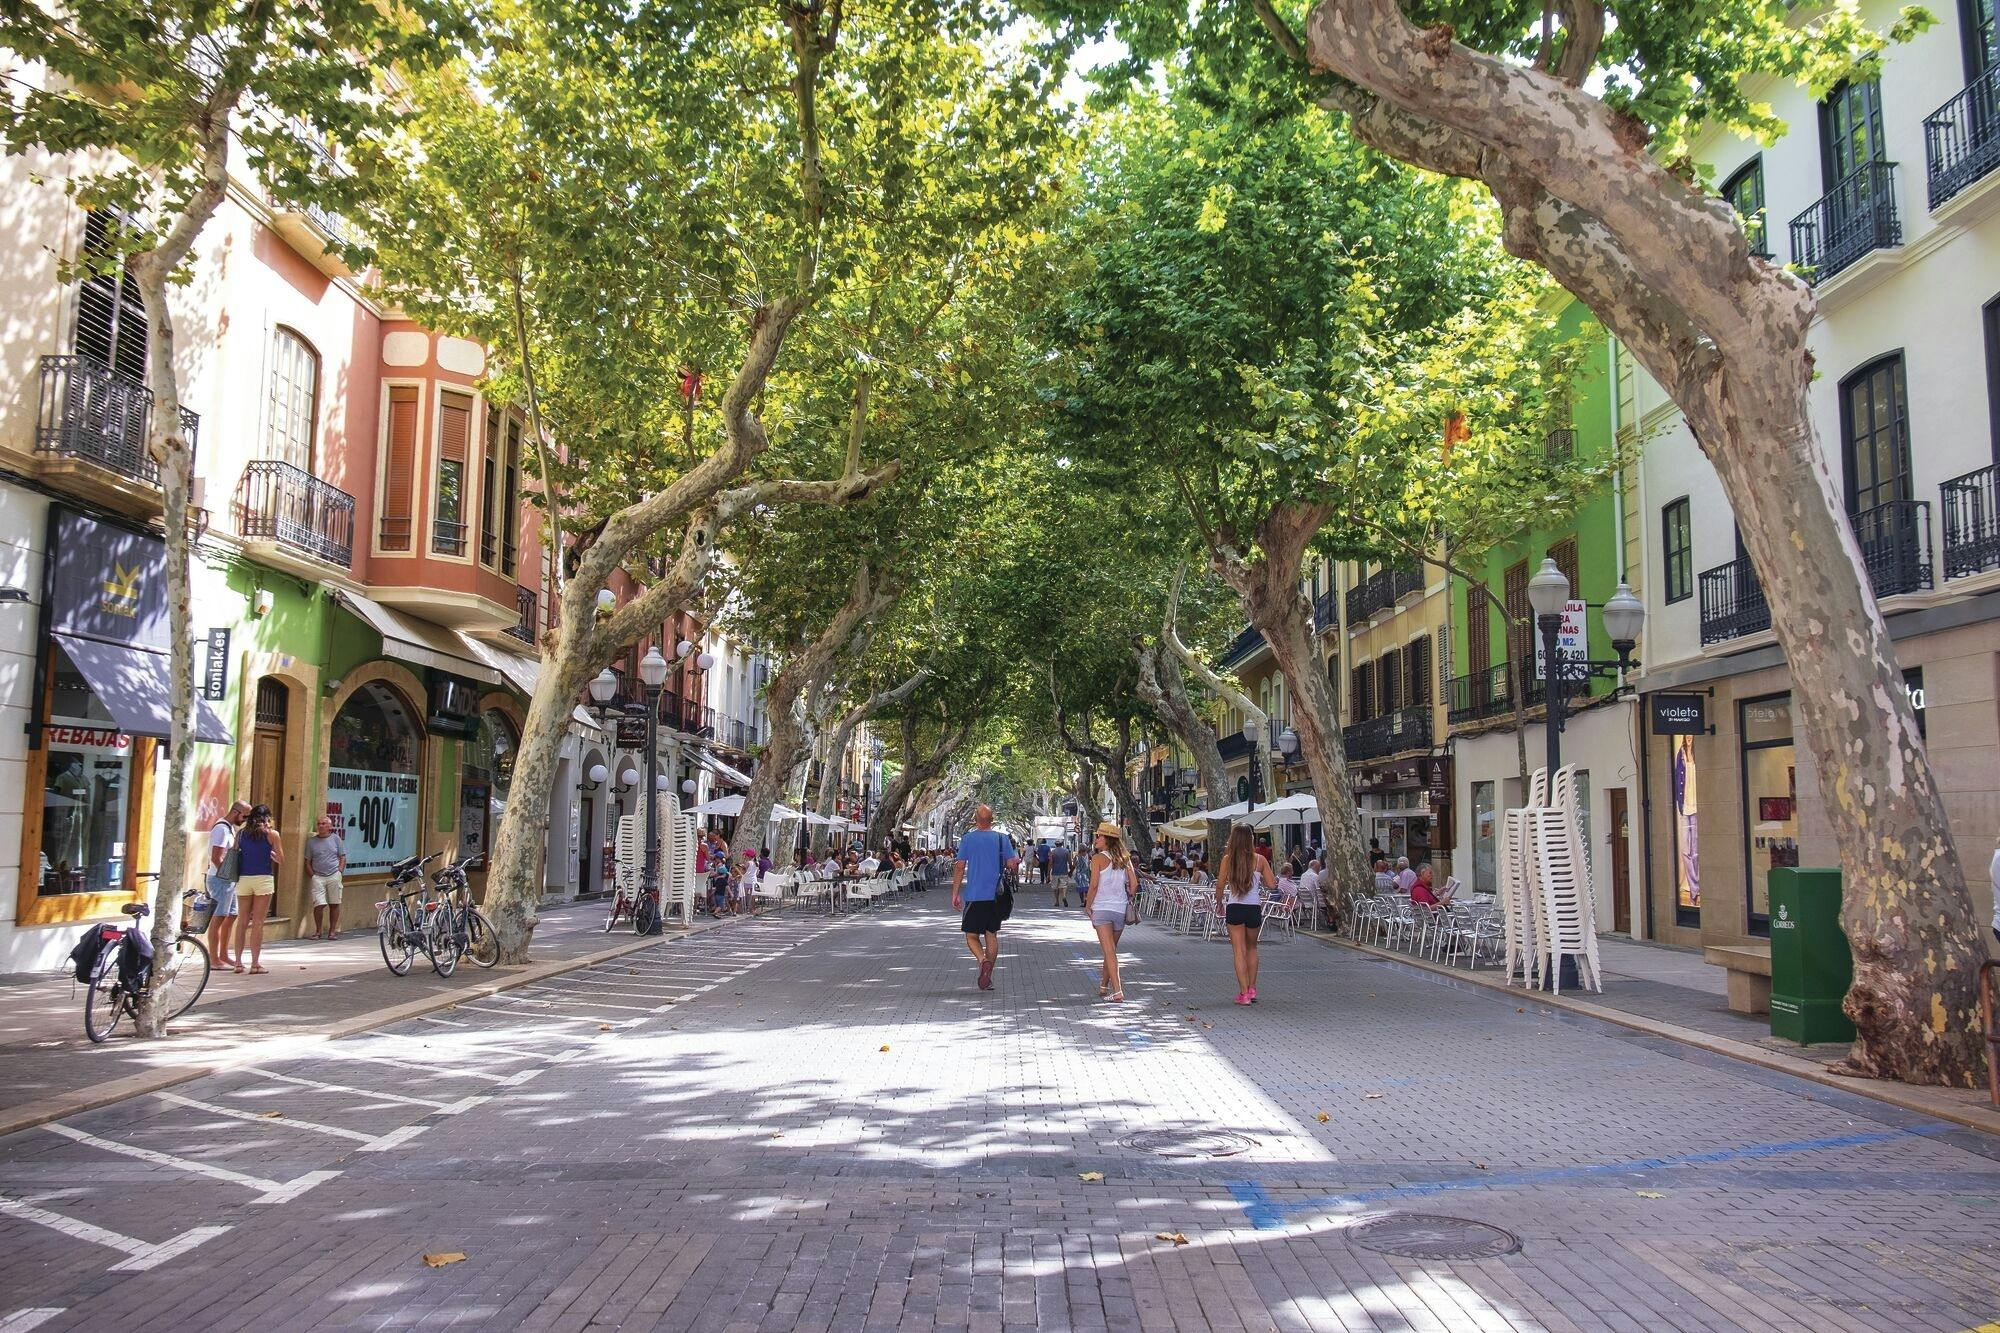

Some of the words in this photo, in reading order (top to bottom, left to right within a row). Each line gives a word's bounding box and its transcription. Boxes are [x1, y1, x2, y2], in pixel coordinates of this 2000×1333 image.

[1561, 603, 1584, 613] UILA
[1570, 650, 1586, 660] 420
[210, 631, 226, 698] sonlak.es
[1660, 706, 1698, 717] violeta
[328, 771, 362, 792] UIDACION
[364, 775, 383, 793] TOTAL
[385, 776, 398, 793] POR
